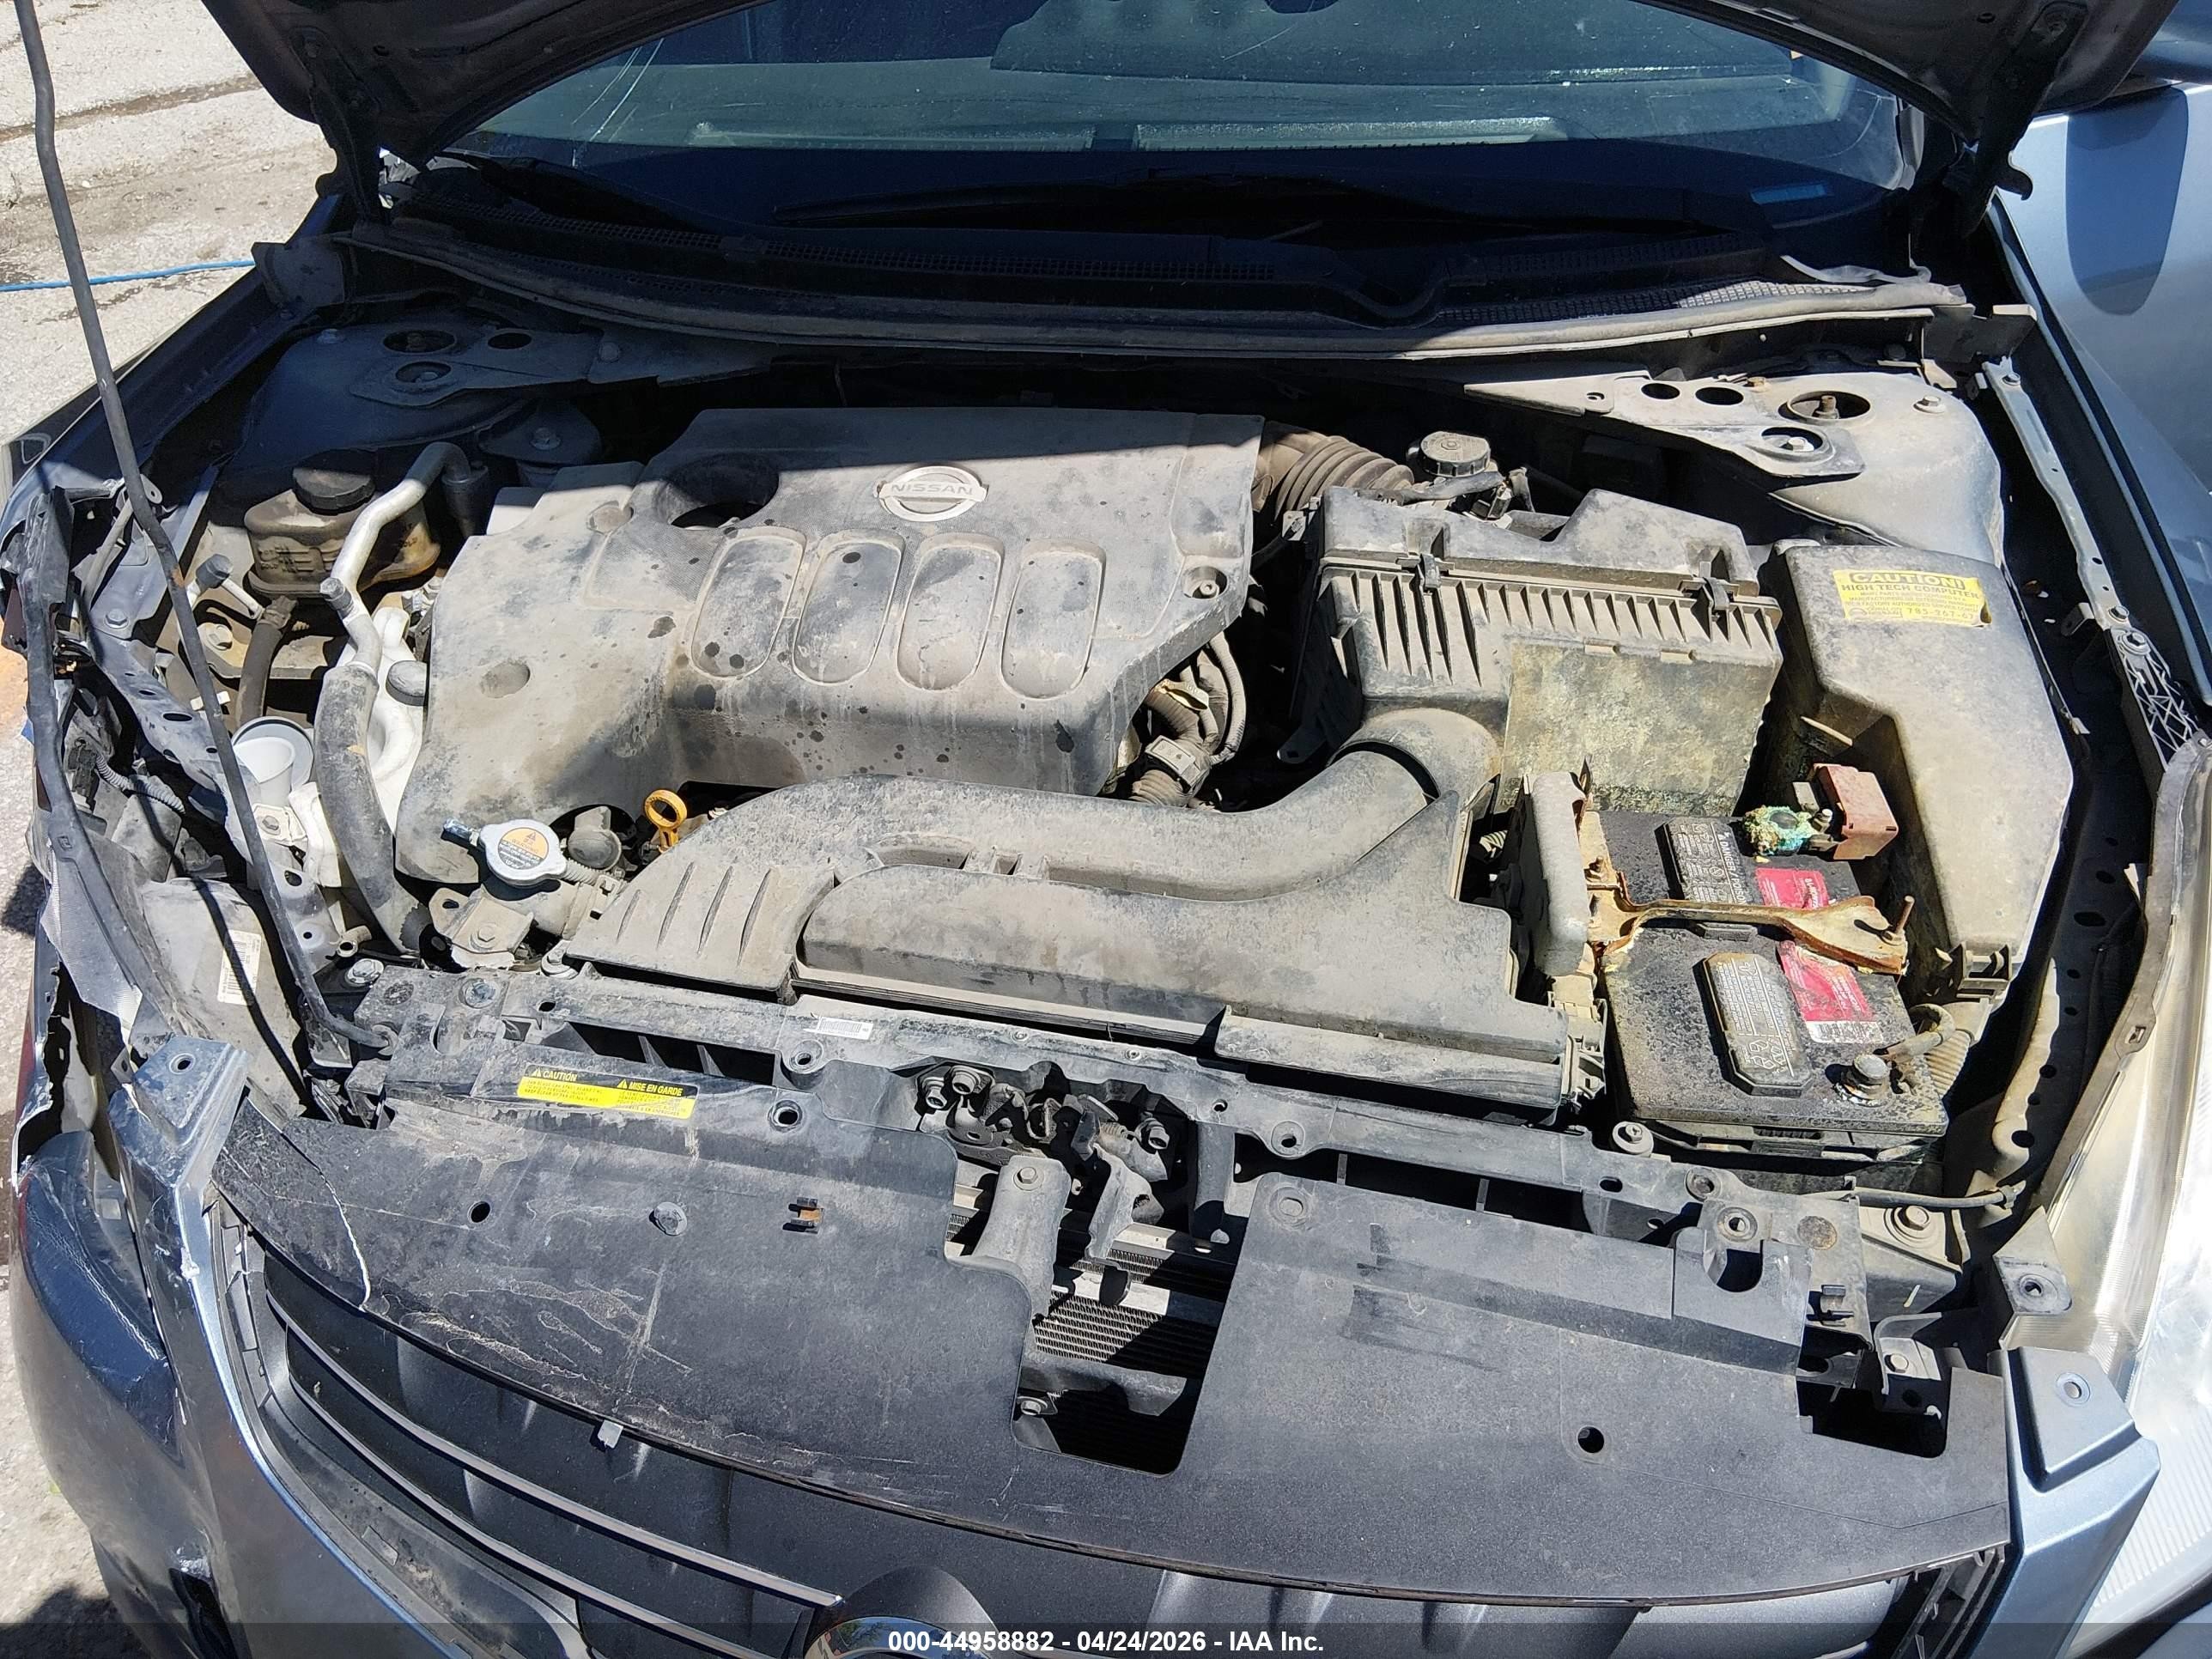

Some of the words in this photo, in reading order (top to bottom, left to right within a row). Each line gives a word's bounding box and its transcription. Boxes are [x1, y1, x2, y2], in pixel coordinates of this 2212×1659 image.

[891, 483, 973, 495] NISSAN
[1852, 572, 1965, 589] CAUTION!
[1914, 585, 1979, 599] COMPUTER
[1719, 842, 1738, 873] DANGER
[543, 1070, 578, 1082] CAUTION
[629, 1081, 646, 1091] MISE
[646, 1083, 657, 1092] EN
[658, 1085, 683, 1097] GARDE
